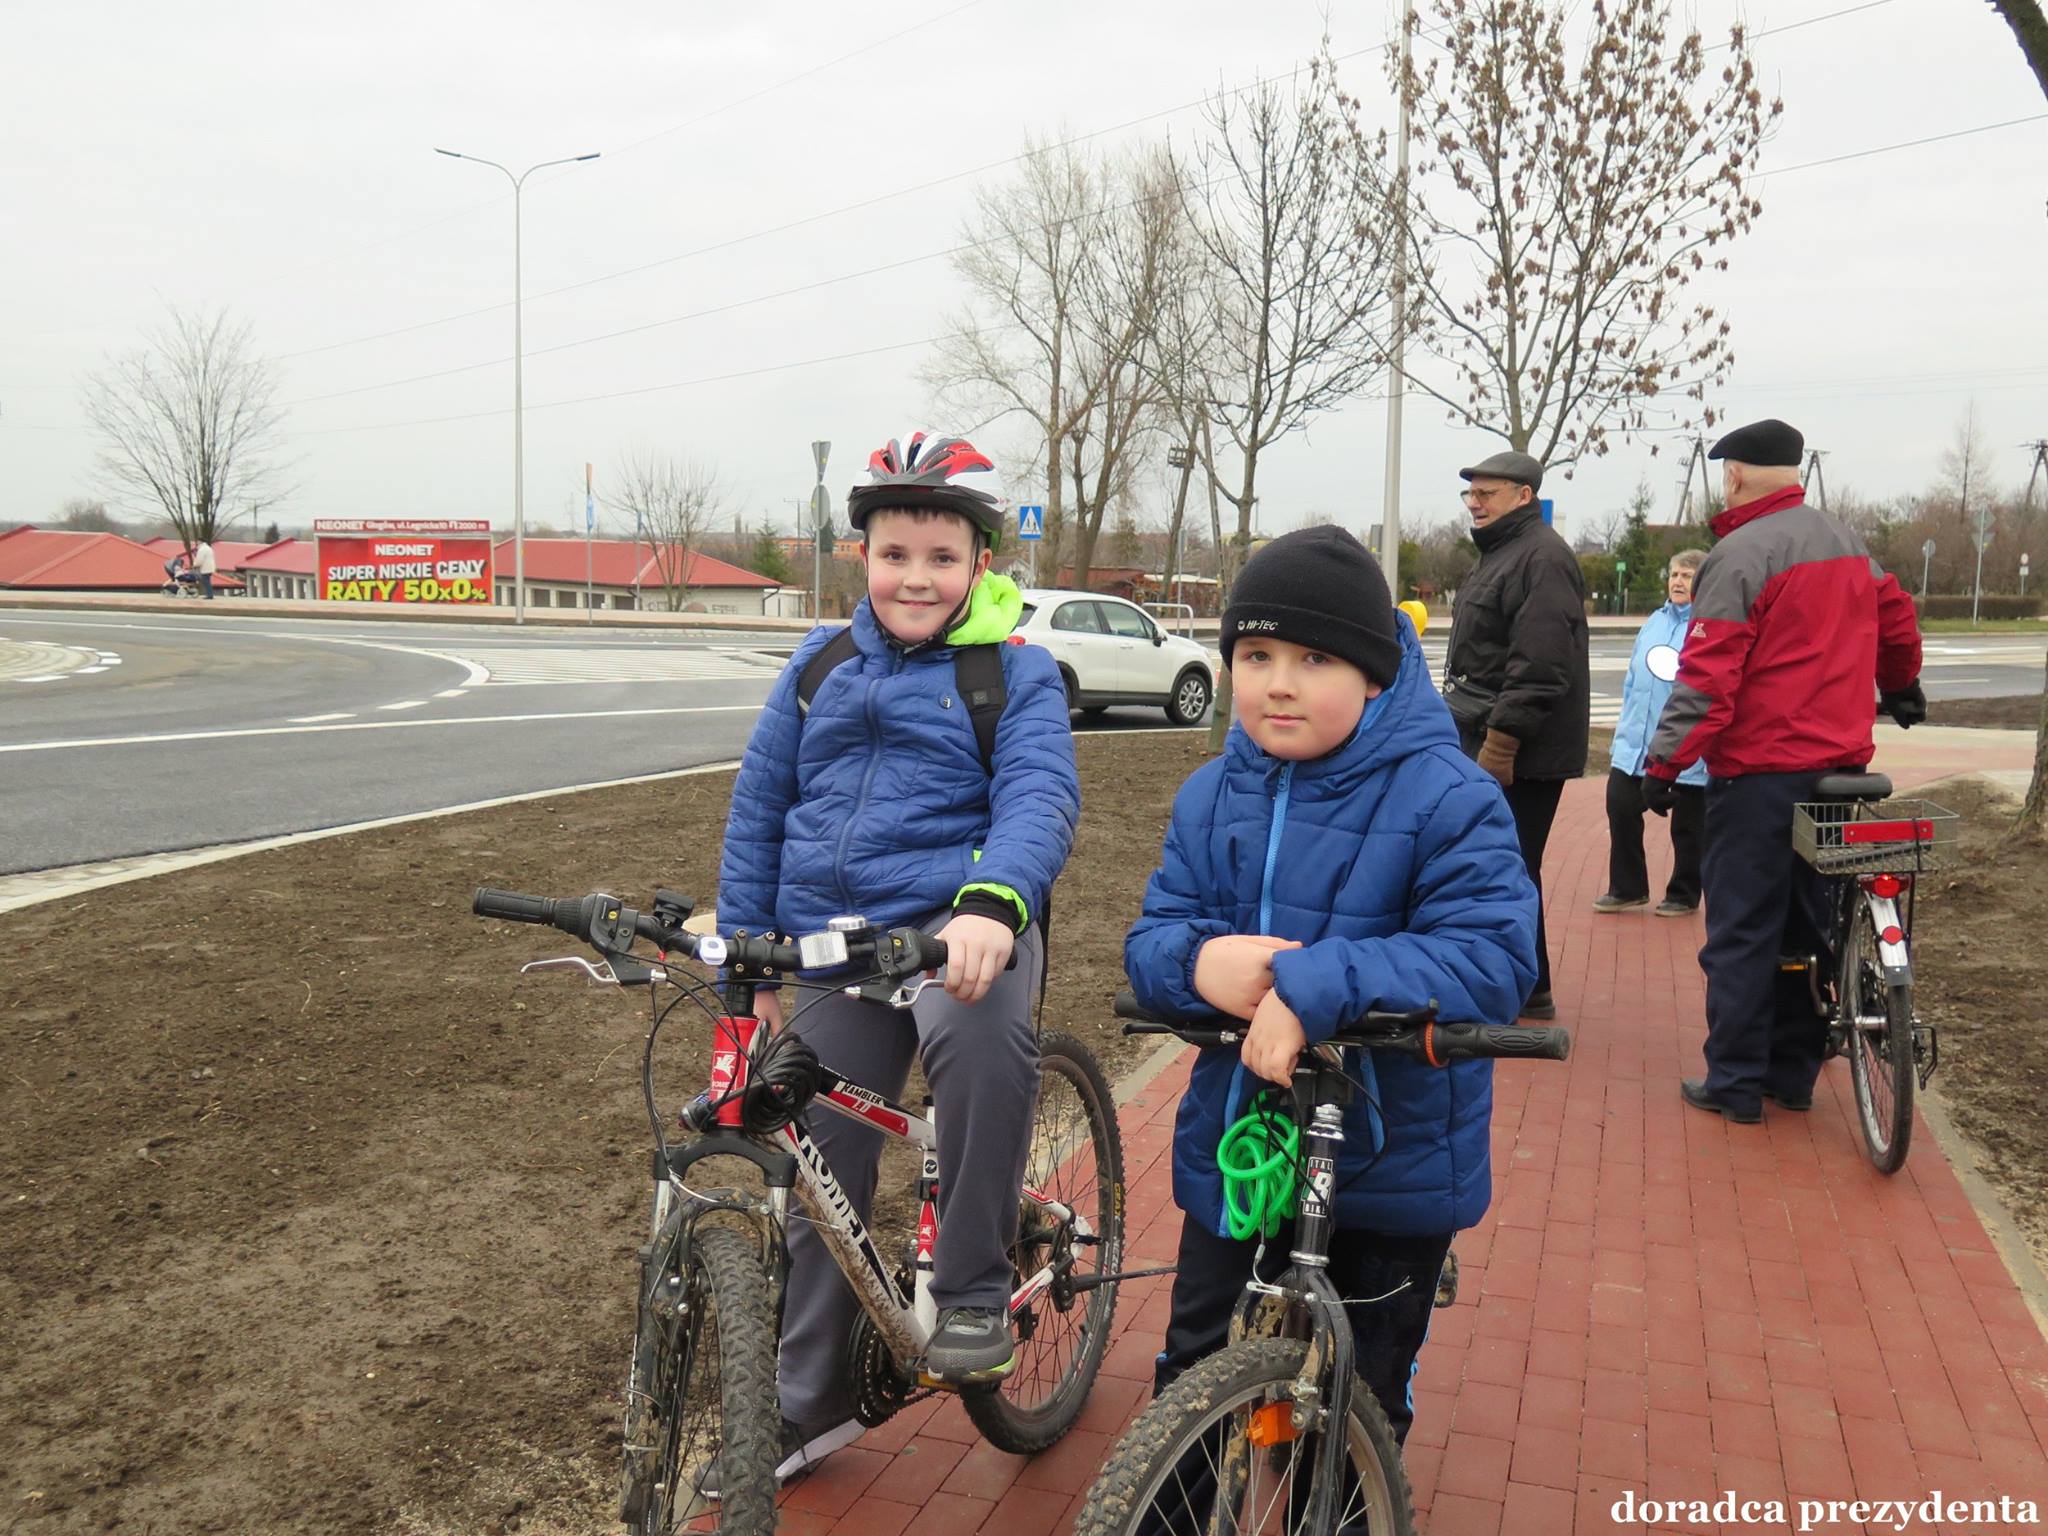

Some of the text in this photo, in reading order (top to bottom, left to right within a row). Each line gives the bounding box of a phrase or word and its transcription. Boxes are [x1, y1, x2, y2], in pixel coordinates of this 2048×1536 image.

[316, 520, 365, 530] NEONET
[375, 544, 435, 556] NEONET
[328, 559, 485, 581] SUPER NISKIE CENY
[327, 580, 397, 601] RATY
[1246, 619, 1279, 631] HI-TEC
[841, 1083, 882, 1104] RAMBLER
[1310, 1159, 1332, 1170] ITAL
